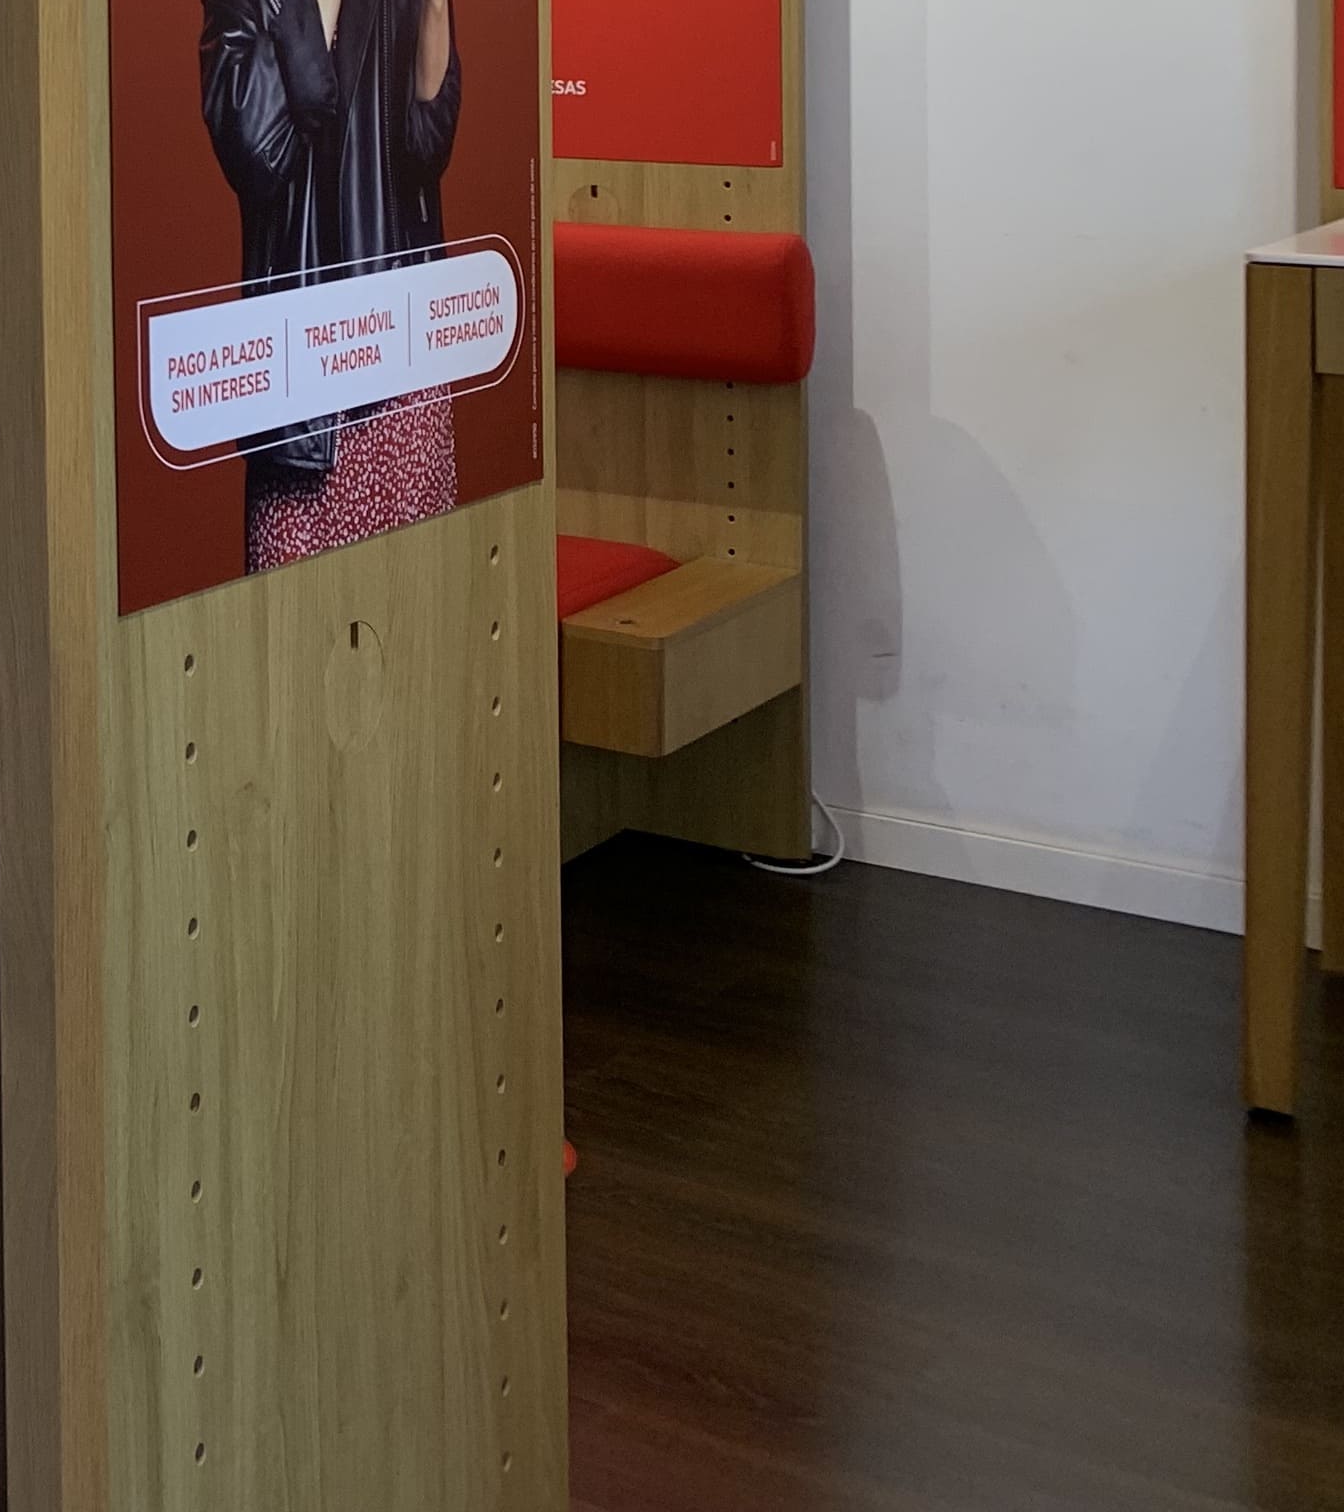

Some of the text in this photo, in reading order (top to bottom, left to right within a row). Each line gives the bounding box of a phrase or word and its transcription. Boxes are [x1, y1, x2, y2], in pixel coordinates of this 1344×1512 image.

[429, 285, 500, 321] SUSTITUCIÓN
[305, 308, 395, 349] TRAE TU MÓVIL
[426, 314, 504, 352] Y REPARACIÓN
[167, 336, 274, 381] PAGO A PLAZOS
[320, 343, 382, 377] Y AHORRA
[172, 369, 271, 414] SIN INTERESES
